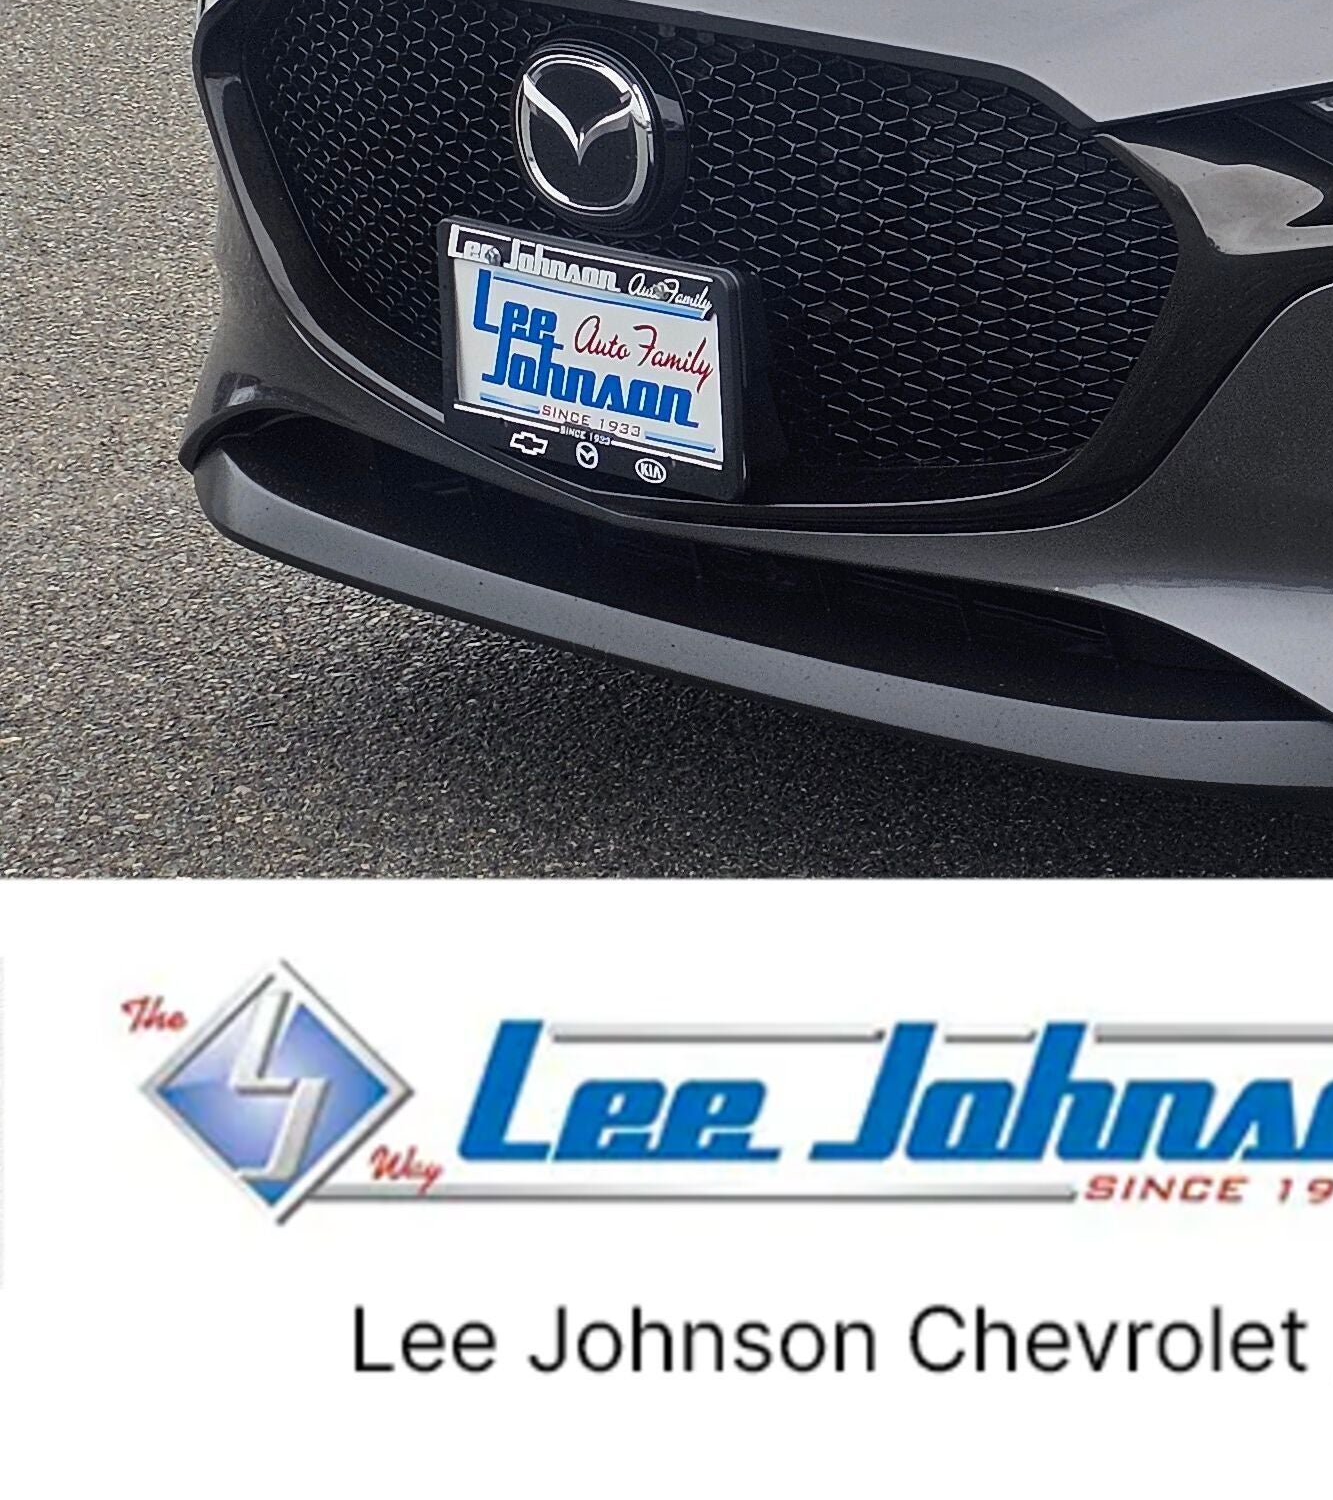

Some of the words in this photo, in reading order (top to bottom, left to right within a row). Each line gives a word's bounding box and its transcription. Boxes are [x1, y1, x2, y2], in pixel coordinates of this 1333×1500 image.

[503, 237, 621, 293] Johnson
[664, 278, 713, 319] Family
[473, 268, 564, 351] Lee
[574, 315, 631, 360] Auto
[633, 324, 714, 393] Family
[482, 335, 699, 428] Johnson
[541, 404, 591, 427] SINCE
[599, 417, 641, 438] 1933
[560, 425, 586, 441] SINCE
